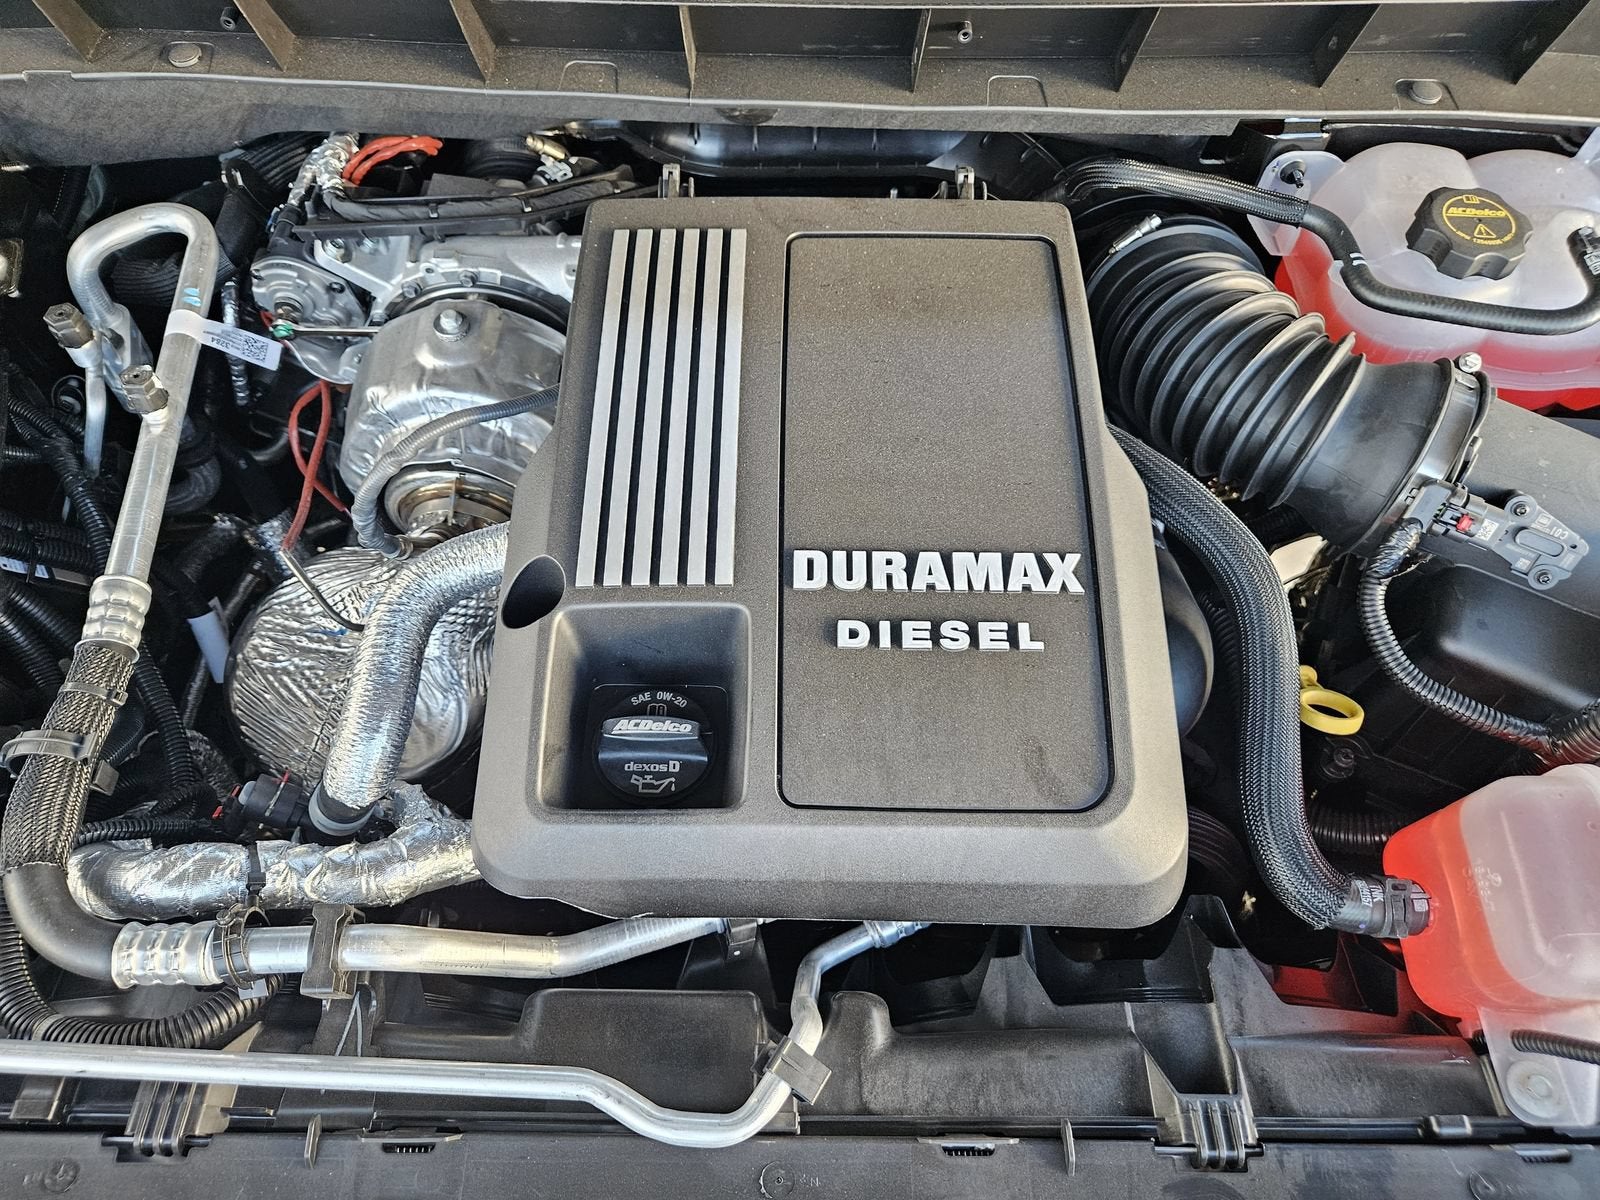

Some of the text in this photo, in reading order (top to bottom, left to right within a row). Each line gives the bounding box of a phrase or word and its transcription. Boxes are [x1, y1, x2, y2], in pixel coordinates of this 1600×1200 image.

[1446, 206, 1506, 217] ACDelco
[793, 550, 1085, 595] DURAMAX
[837, 619, 1045, 651] DIESEL
[630, 691, 688, 708] SAE 0W-20
[612, 719, 693, 733] ACDelco
